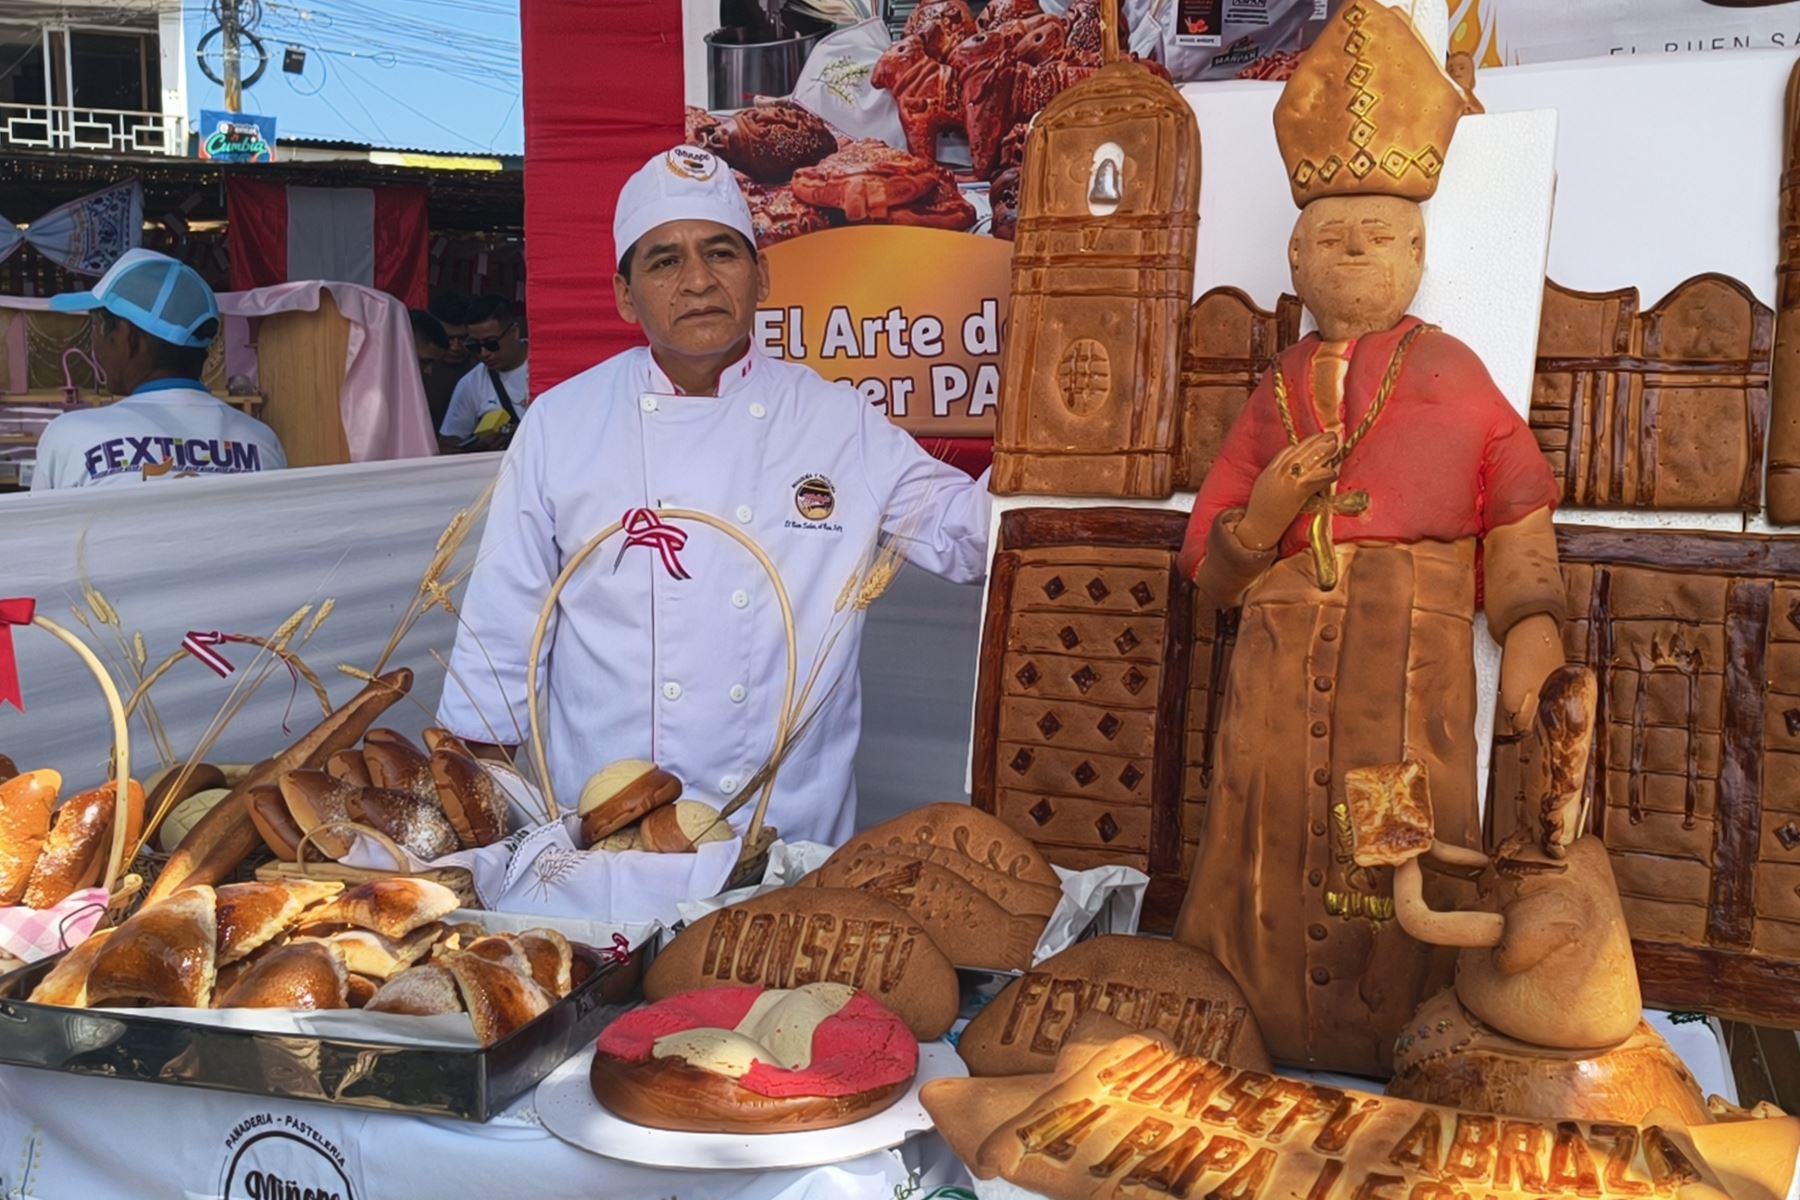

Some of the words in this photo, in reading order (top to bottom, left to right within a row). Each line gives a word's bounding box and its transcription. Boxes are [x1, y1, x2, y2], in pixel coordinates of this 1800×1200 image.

[206, 133, 268, 156] Cumbia
[753, 306, 807, 359] El
[819, 305, 944, 359] Arte
[961, 298, 1010, 356] d
[84, 436, 262, 477] FEXTICUM
[284, 1114, 346, 1168] PASTELERIA
[1088, 1116, 1278, 1200] PAPA
[1387, 1110, 1702, 1198] ABRAZA
